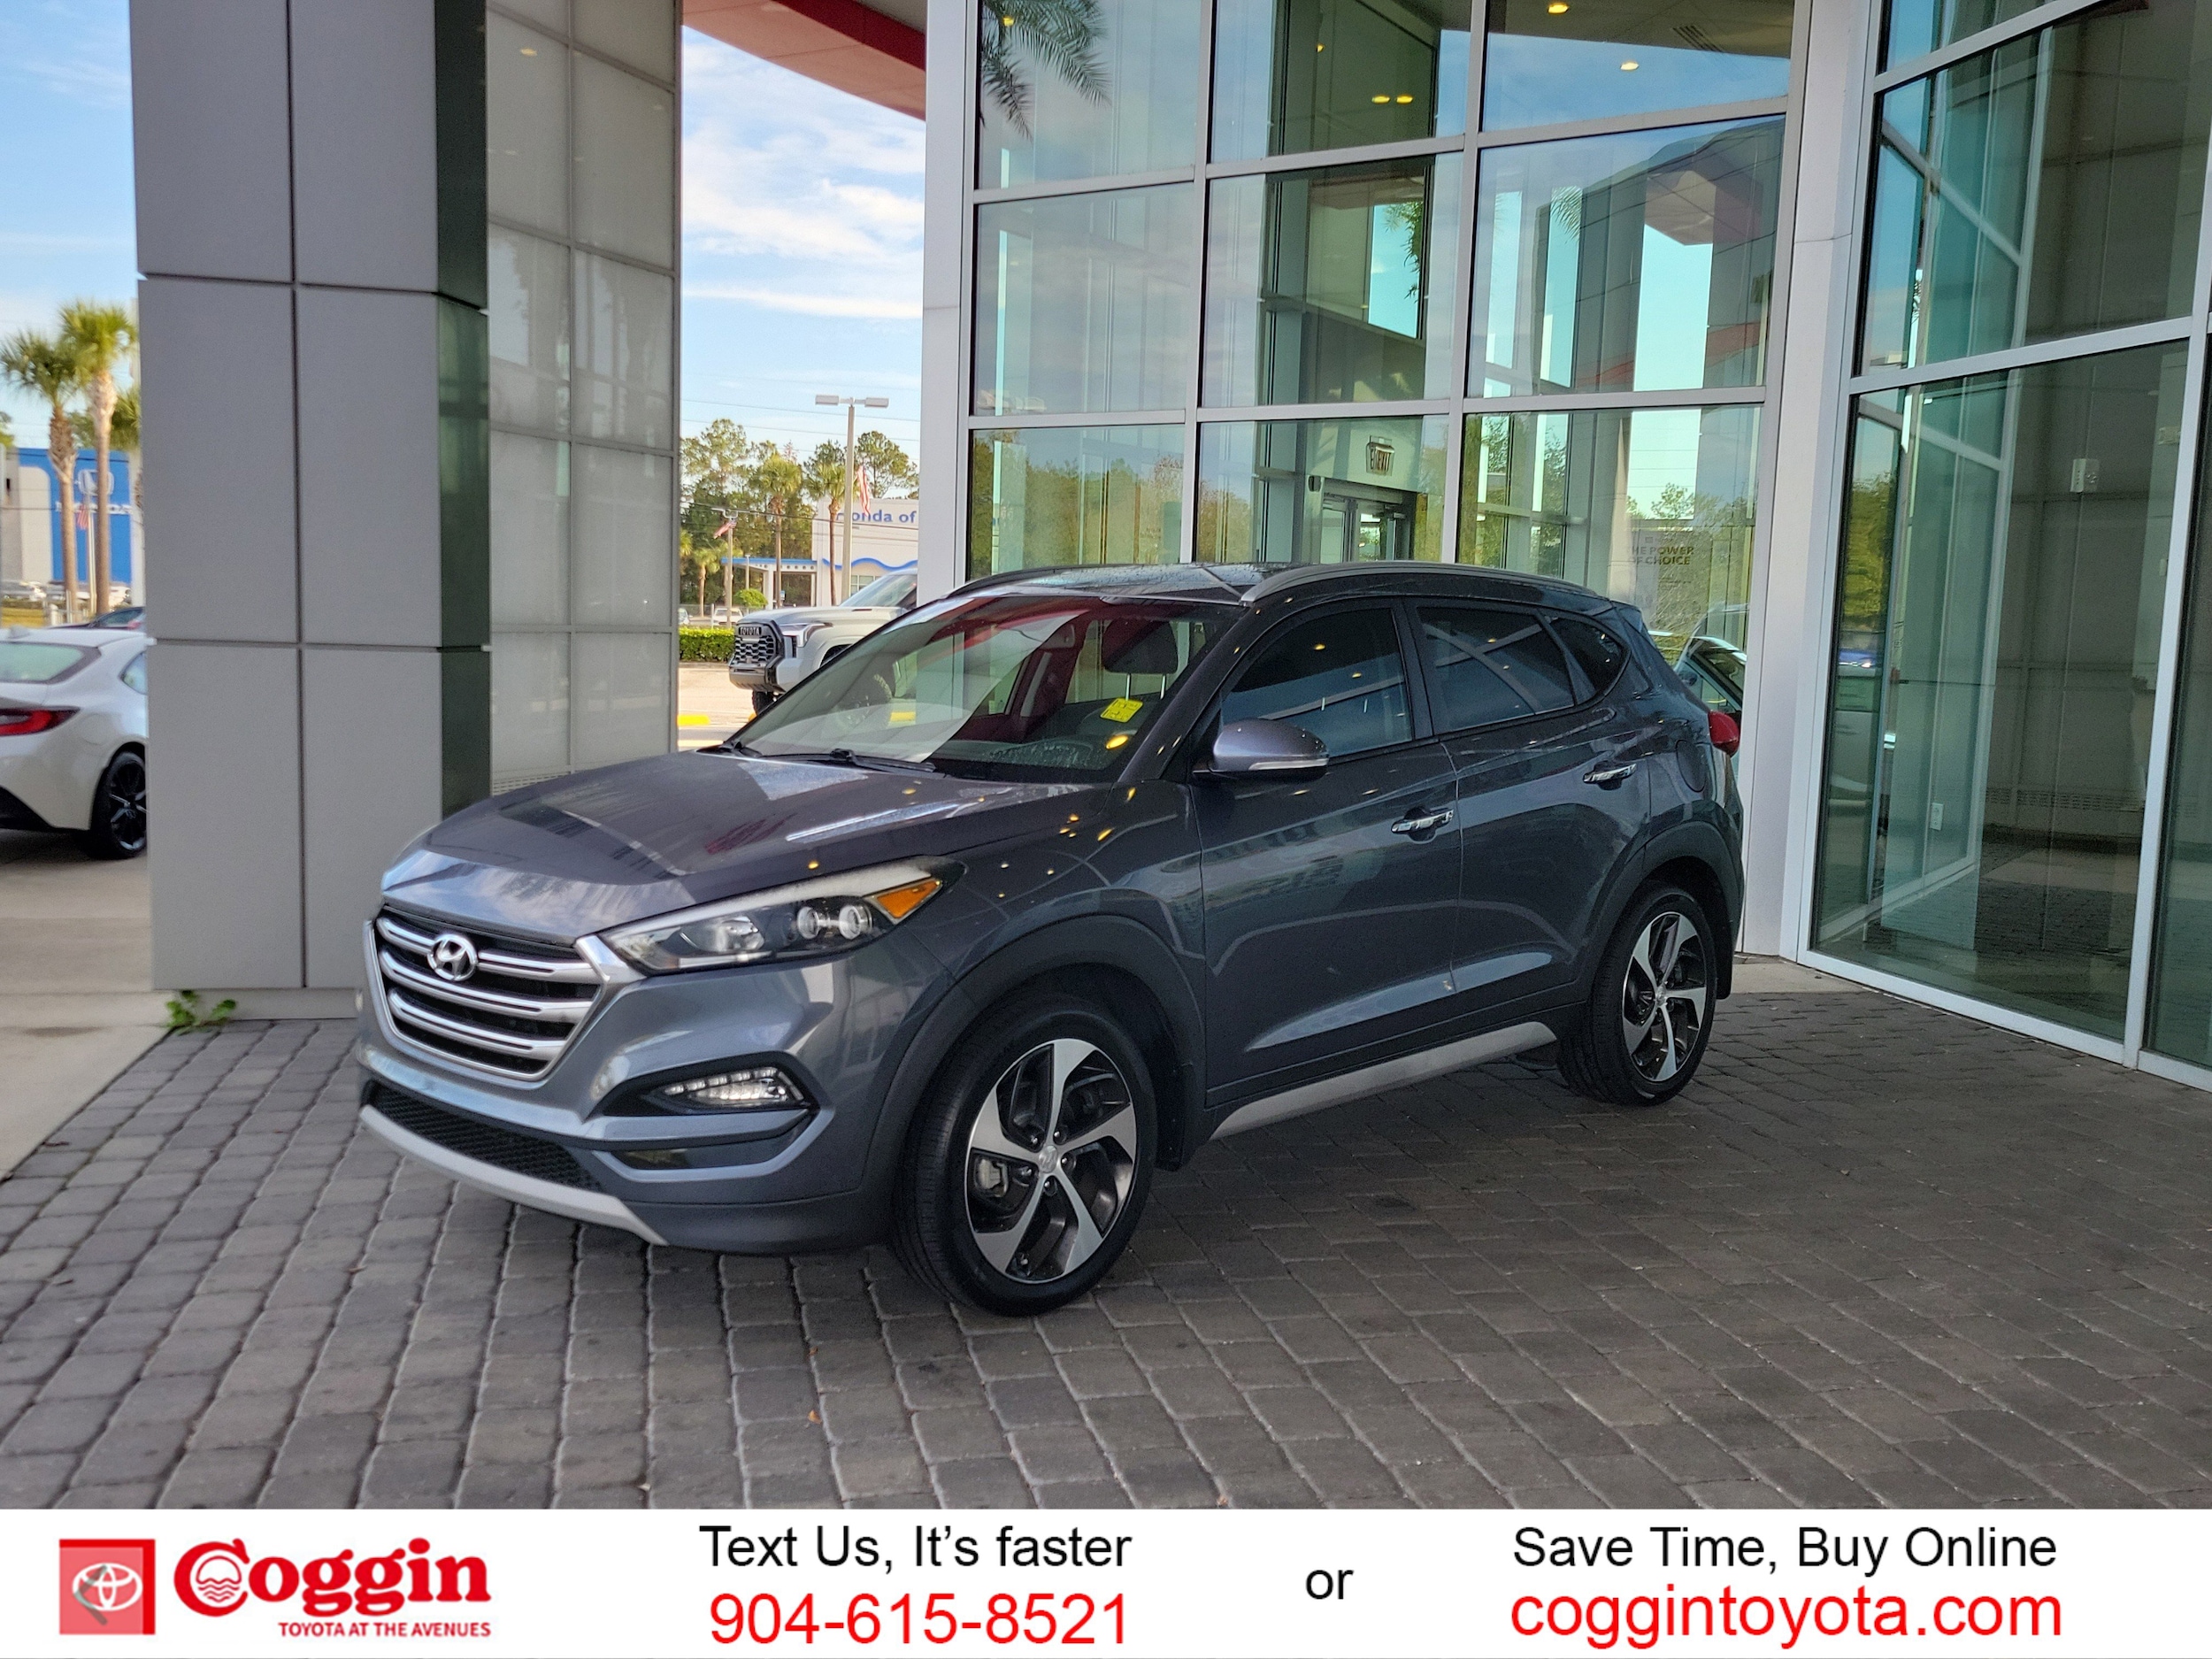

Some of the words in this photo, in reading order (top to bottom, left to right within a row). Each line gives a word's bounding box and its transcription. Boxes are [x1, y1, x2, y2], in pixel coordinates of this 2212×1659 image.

[898, 511, 918, 523] of
[1649, 546, 1694, 555] POWER
[1646, 556, 1691, 565] CHOICE
[740, 626, 760, 636] TOYOTA
